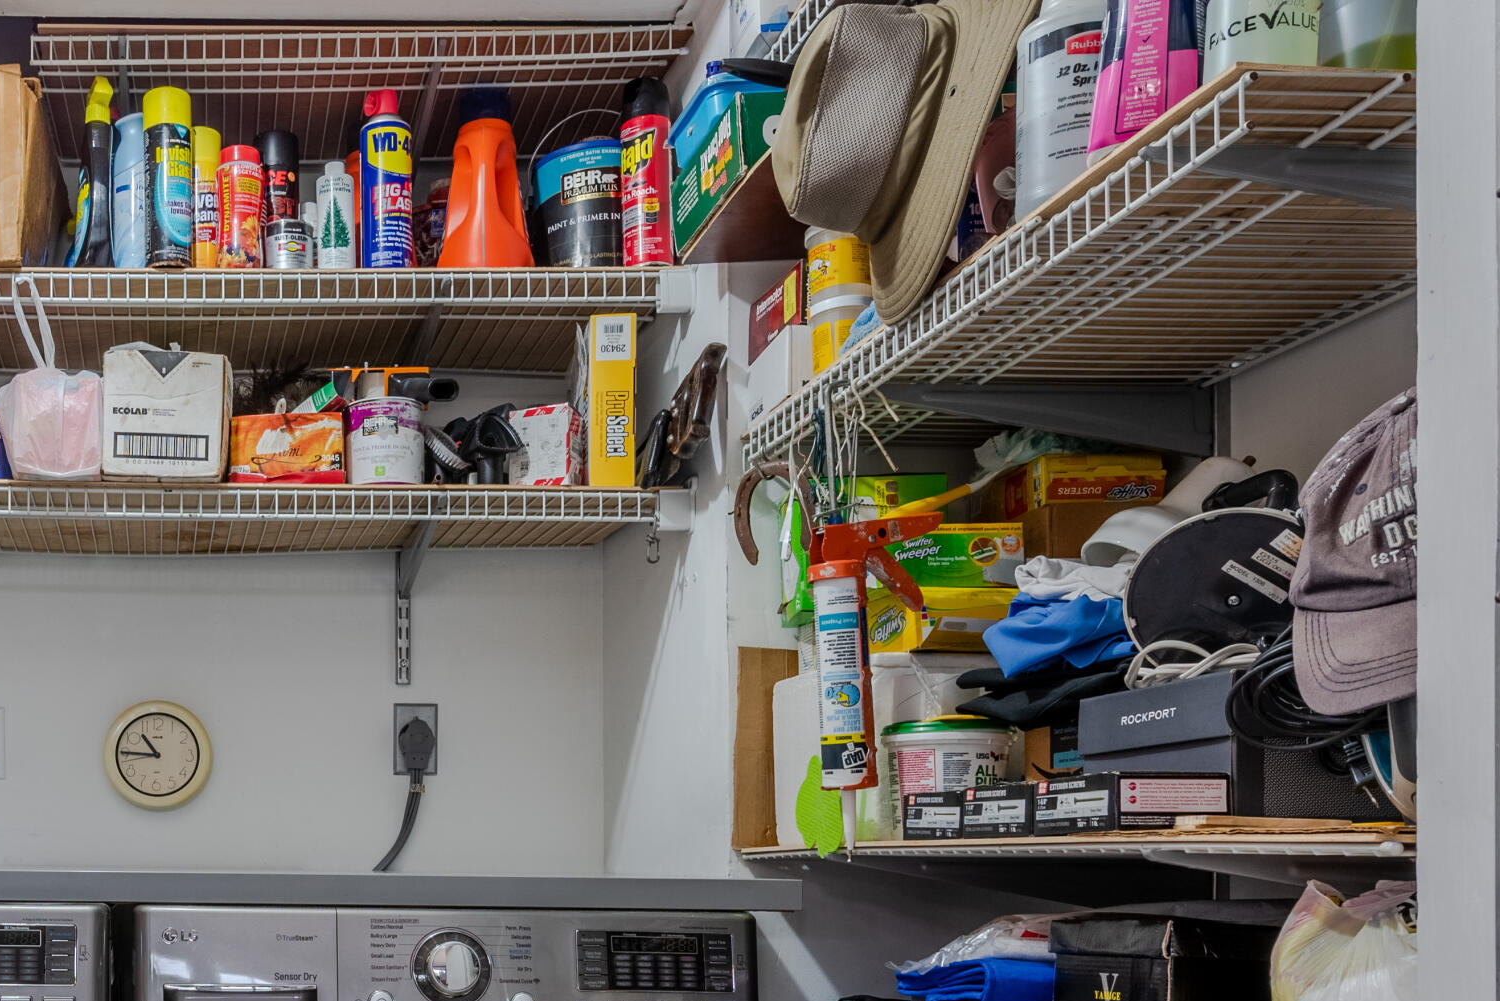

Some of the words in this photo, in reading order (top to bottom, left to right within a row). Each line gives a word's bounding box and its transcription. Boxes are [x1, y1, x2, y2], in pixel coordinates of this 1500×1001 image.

[563, 169, 602, 191] BEHR
[374, 183, 401, 199] BIG
[563, 185, 598, 199] PREMIUM
[600, 183, 618, 192] PLUS
[223, 176, 232, 232] DYNAMITE
[577, 212, 609, 224] PRIMER
[600, 343, 626, 354] 29430
[112, 406, 149, 417] ECOLAB
[605, 389, 630, 459] ProSelect
[1057, 485, 1103, 496] DUSTERS
[1107, 481, 1158, 500] Swiffer
[904, 537, 934, 550] Swiffer
[894, 544, 942, 563] Sweeper
[876, 605, 897, 623] Dusters
[870, 611, 906, 645] Swiffer
[1120, 706, 1177, 727] ROCKPORT
[152, 717, 164, 731] 12
[126, 731, 141, 745] 10
[179, 730, 189, 744] 2
[185, 748, 195, 762] 3
[843, 749, 866, 767] DAP
[976, 752, 990, 760] USG
[125, 764, 136, 777] 8
[178, 766, 187, 779] 4
[975, 764, 998, 777] ALL
[140, 774, 147, 788] 7
[151, 778, 161, 792] 6
[167, 776, 177, 789] 5
[274, 972, 302, 981] Sensor
[302, 972, 318, 983] Dry
